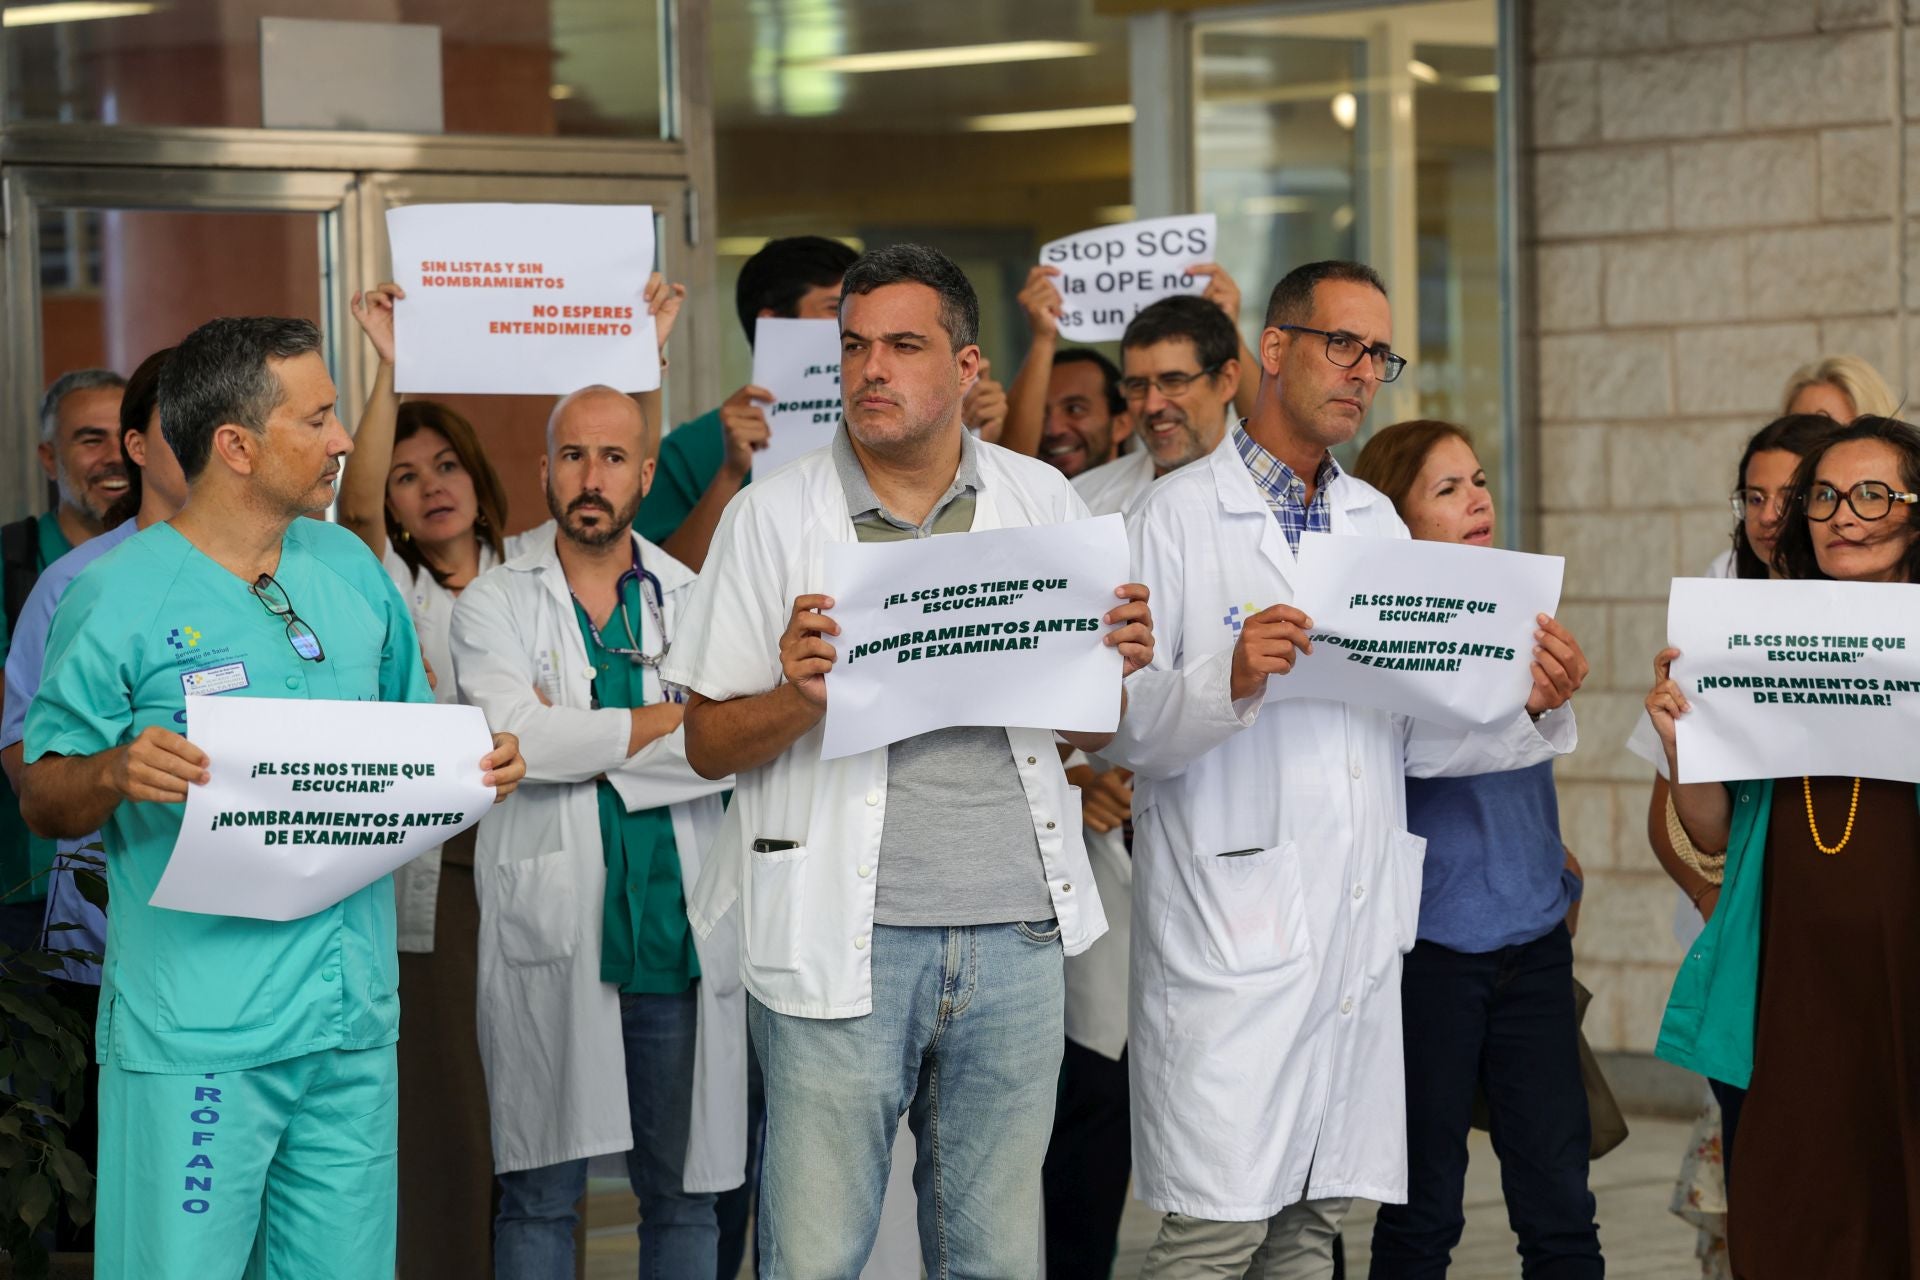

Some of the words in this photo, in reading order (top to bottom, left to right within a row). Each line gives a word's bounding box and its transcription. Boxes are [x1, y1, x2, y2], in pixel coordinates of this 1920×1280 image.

[1136, 228, 1208, 258] SCS
[421, 260, 448, 273] SIN
[450, 261, 503, 274] LISTAS
[505, 262, 515, 274] Y
[517, 263, 543, 274] SIN
[422, 275, 565, 289] NOMBRAMIENTOS
[1063, 274, 1087, 295] la
[1095, 270, 1154, 294] OPE
[1163, 270, 1195, 290] no
[532, 305, 559, 318] NO
[562, 305, 633, 319] ESPERES
[1092, 309, 1125, 325] un
[489, 321, 632, 336] ENTENDIMIENTO
[825, 364, 841, 374] SC
[771, 399, 842, 417] ¡NOMBRA
[812, 412, 832, 424] DE
[883, 593, 908, 610] ¡EL
[911, 588, 940, 602] SCS
[942, 584, 977, 597] NOS
[980, 579, 1029, 594] TIENE
[1031, 578, 1068, 593] QUE
[1349, 594, 1369, 609] ¡EL
[1370, 594, 1394, 607] SCS
[1395, 595, 1424, 608] NOS
[1425, 596, 1465, 610] TIENE
[1466, 600, 1497, 614] QUE
[848, 620, 1032, 665] ¡NOMBRAMIENTOS
[1032, 617, 1099, 633] ANTES
[897, 647, 922, 664] DE
[925, 636, 1039, 658] EXAMINAR!
[1727, 634, 1752, 650] ¡EL
[1753, 634, 1783, 647] SCS
[1785, 635, 1819, 648] NOS
[1821, 635, 1869, 649] TIENE
[1871, 636, 1906, 652] QUE
[1459, 642, 1515, 661] ANTES
[1347, 652, 1373, 665] DE
[1373, 658, 1461, 671] EXAMINAR!
[1698, 677, 1879, 693] ¡NOMBRAMIENTOS
[1883, 679, 1920, 693] ANT
[1753, 691, 1779, 704] DE
[1781, 691, 1892, 707] EXAMINAR!
[250, 762, 278, 779] ¡EL
[280, 762, 311, 776] SCS
[313, 762, 349, 776] NOS
[350, 763, 399, 777] TIENE
[402, 764, 435, 777] QUE
[211, 811, 399, 831] ¡NOMBRAMIENTOS
[401, 812, 465, 827] ANTES
[264, 830, 289, 846] DE
[292, 829, 407, 846] EXAMINAR!
[182, 1073, 223, 1214] RÓFANO
